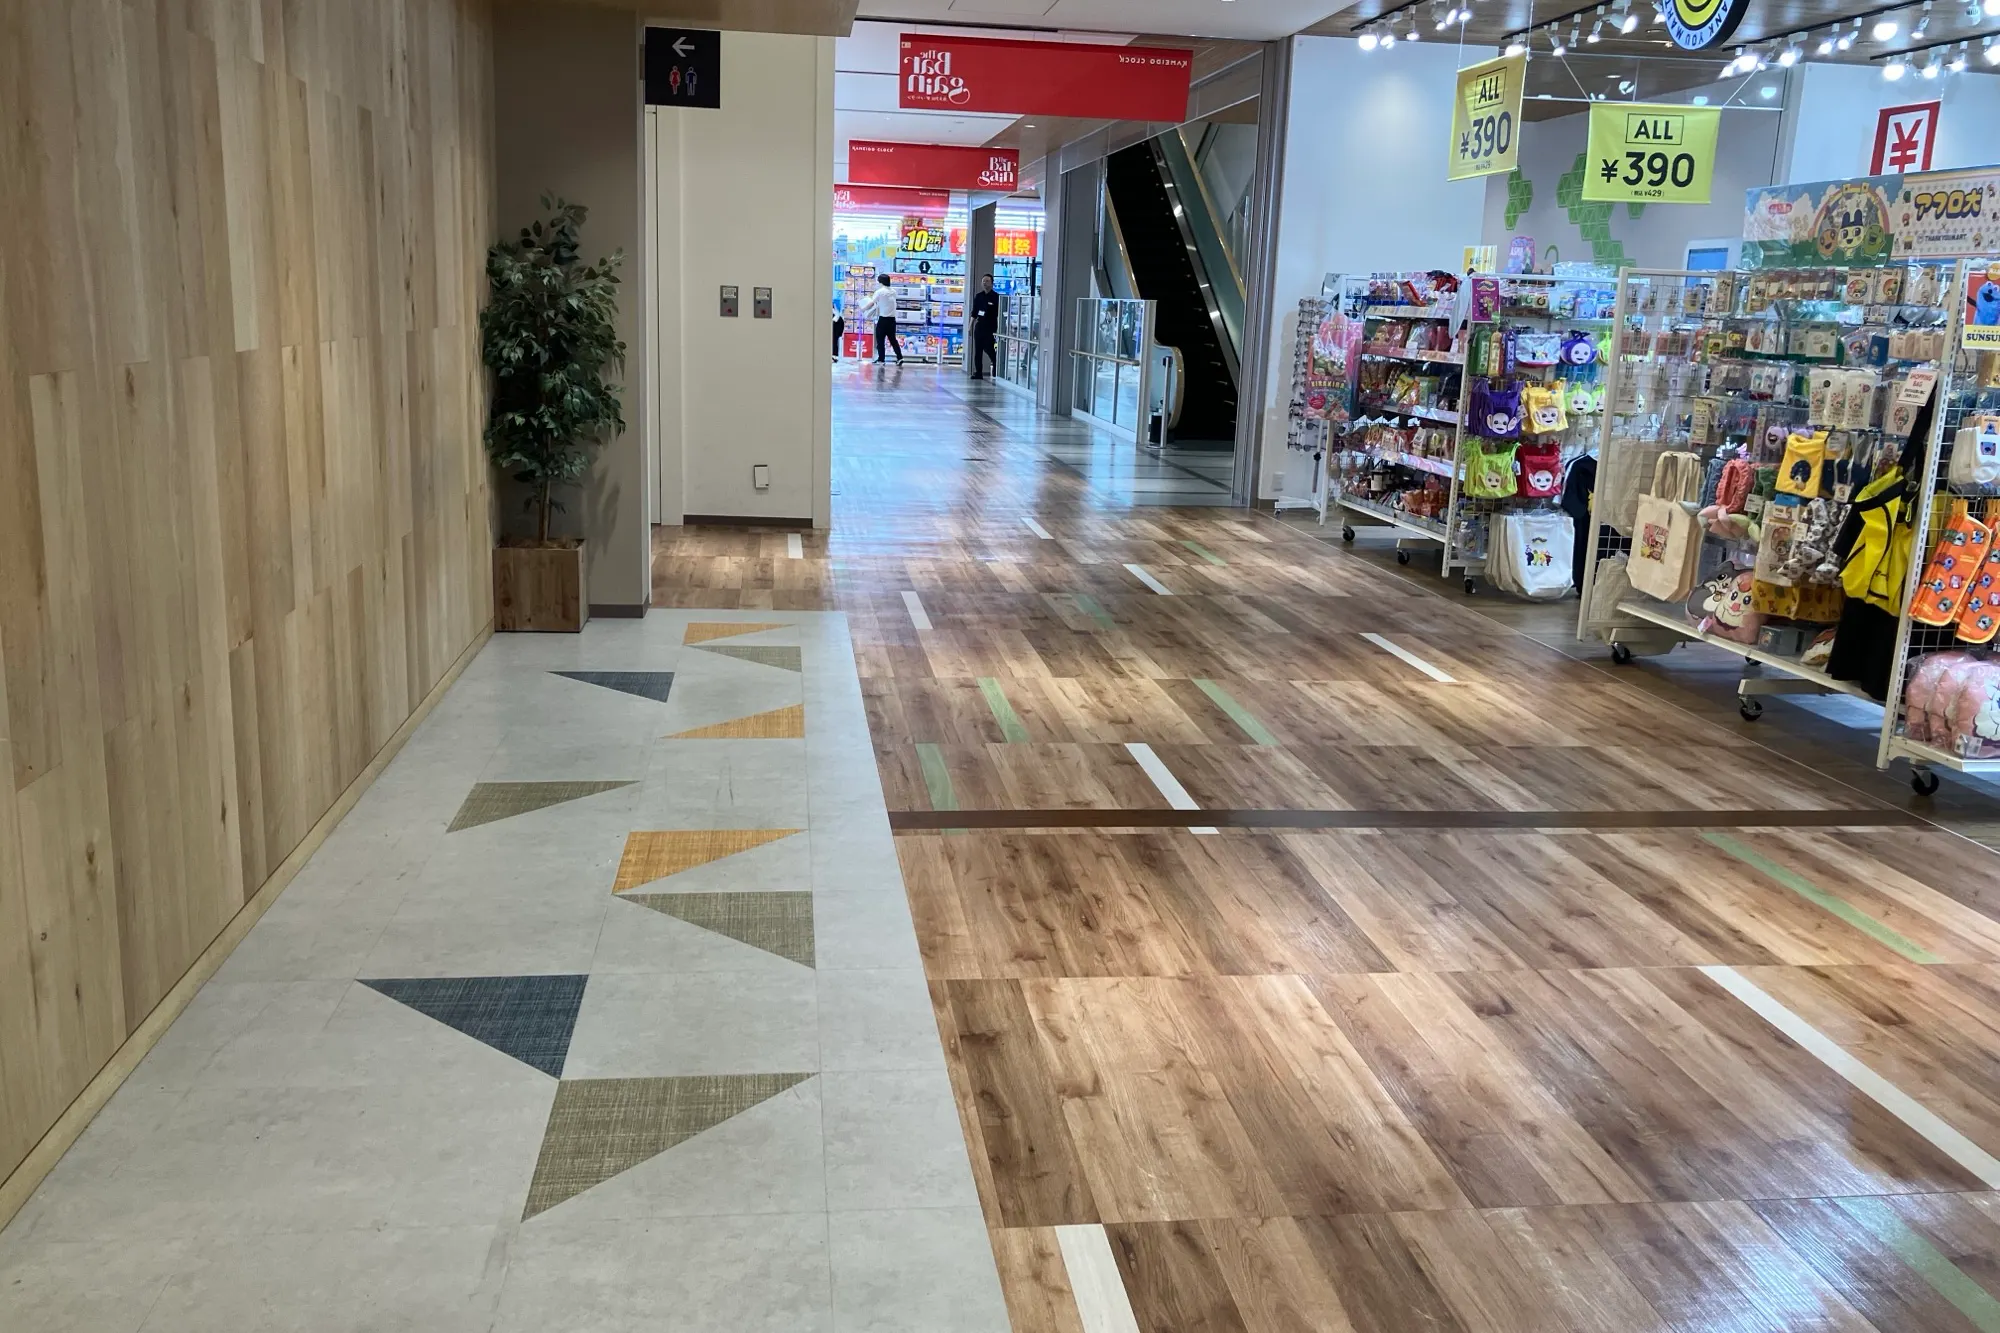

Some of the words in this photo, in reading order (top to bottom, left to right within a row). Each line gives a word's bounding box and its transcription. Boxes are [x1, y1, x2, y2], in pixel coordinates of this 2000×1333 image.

[1685, 32, 1704, 46] YOU
[1478, 75, 1500, 104] ALL
[1460, 111, 1511, 160] ¥390
[1633, 119, 1673, 140] ALL
[990, 156, 1017, 171] Bar
[1601, 151, 1695, 188] ¥390
[977, 170, 1014, 187] gain
[907, 229, 929, 252] 10
